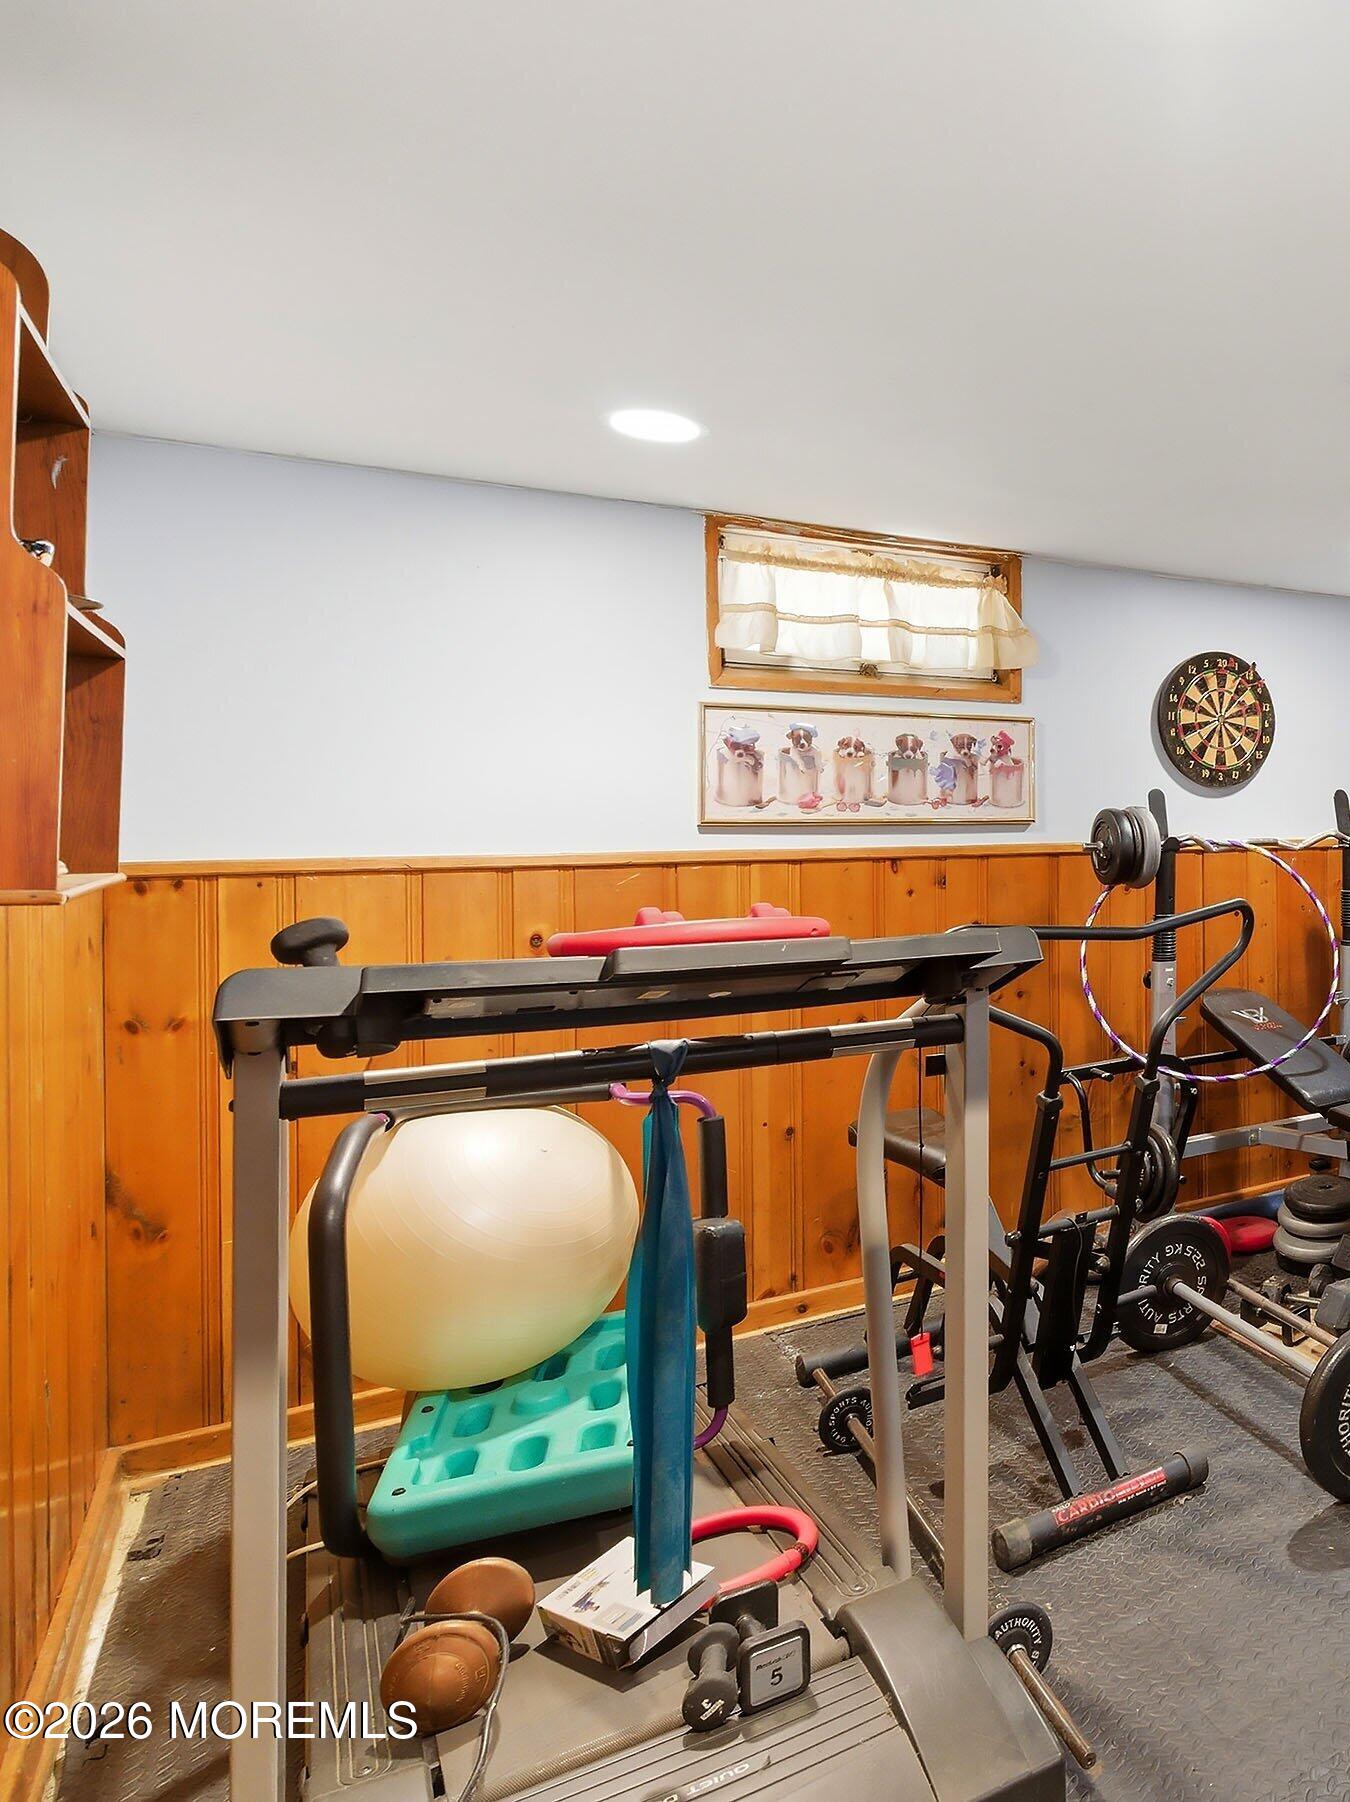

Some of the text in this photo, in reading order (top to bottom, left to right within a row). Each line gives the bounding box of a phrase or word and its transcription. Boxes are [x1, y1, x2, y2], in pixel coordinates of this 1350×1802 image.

[1203, 659, 1209, 668] 5
[1217, 659, 1228, 667] 20
[1234, 662, 1238, 670] 1
[1188, 665, 1197, 674] 12
[1179, 677, 1185, 685] 9
[1263, 703, 1270, 711] 13
[1168, 711, 1175, 720] 11
[1264, 719, 1269, 728] 6
[1263, 735, 1270, 744] 10
[1176, 746, 1185, 755] 16
[1189, 760, 1194, 769] 7
[1246, 763, 1252, 771] 2
[1202, 769, 1210, 778] 19
[1218, 772, 1224, 781] 3
[1058, 1489, 1117, 1523] CARDIO
[994, 1617, 1042, 1645] AUTHORITY
[770, 1665, 784, 1686] 5
[687, 1762, 750, 1796] QUIET
